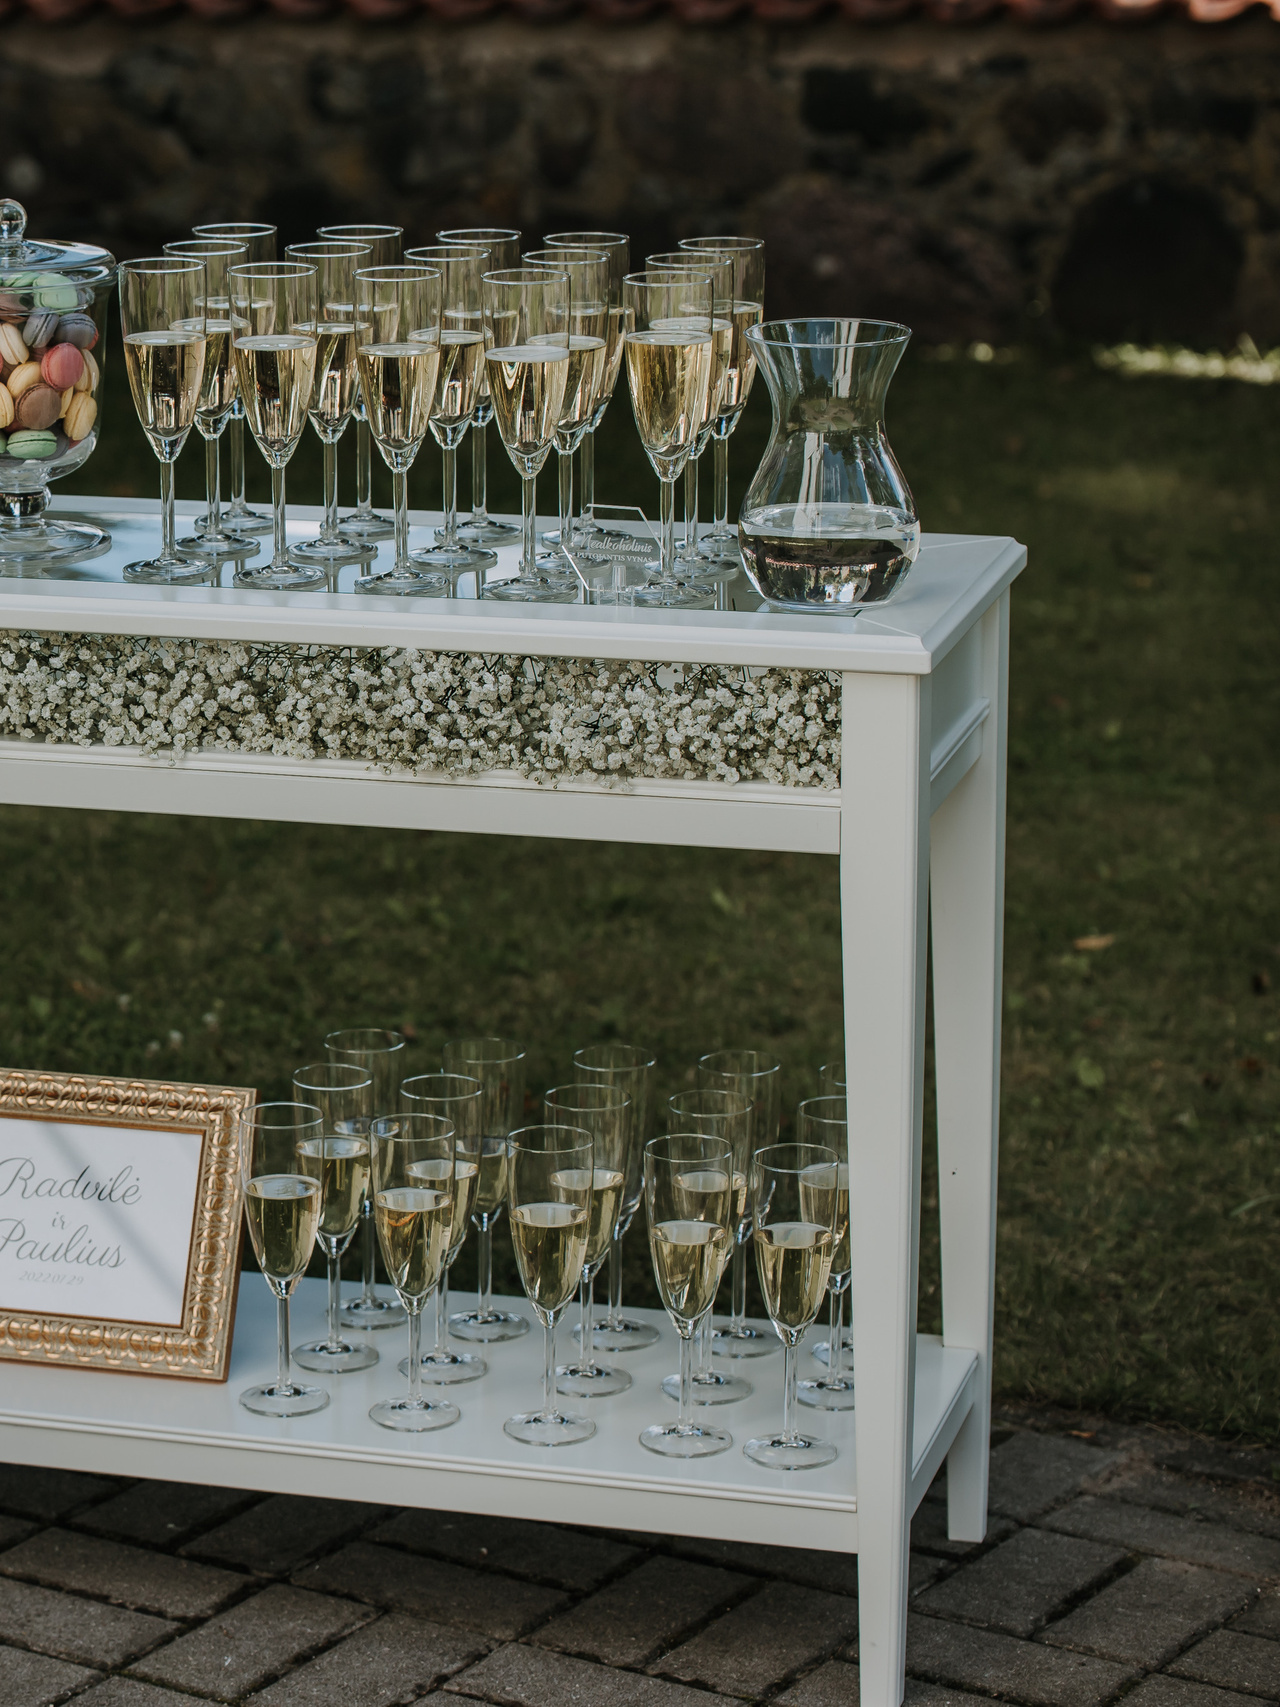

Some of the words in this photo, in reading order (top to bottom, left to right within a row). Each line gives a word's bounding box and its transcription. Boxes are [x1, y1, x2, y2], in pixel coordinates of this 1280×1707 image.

[572, 531, 653, 553] Nealkoholinis
[577, 552, 625, 561] PUTOJANTIS
[51, 1211, 67, 1230] ir
